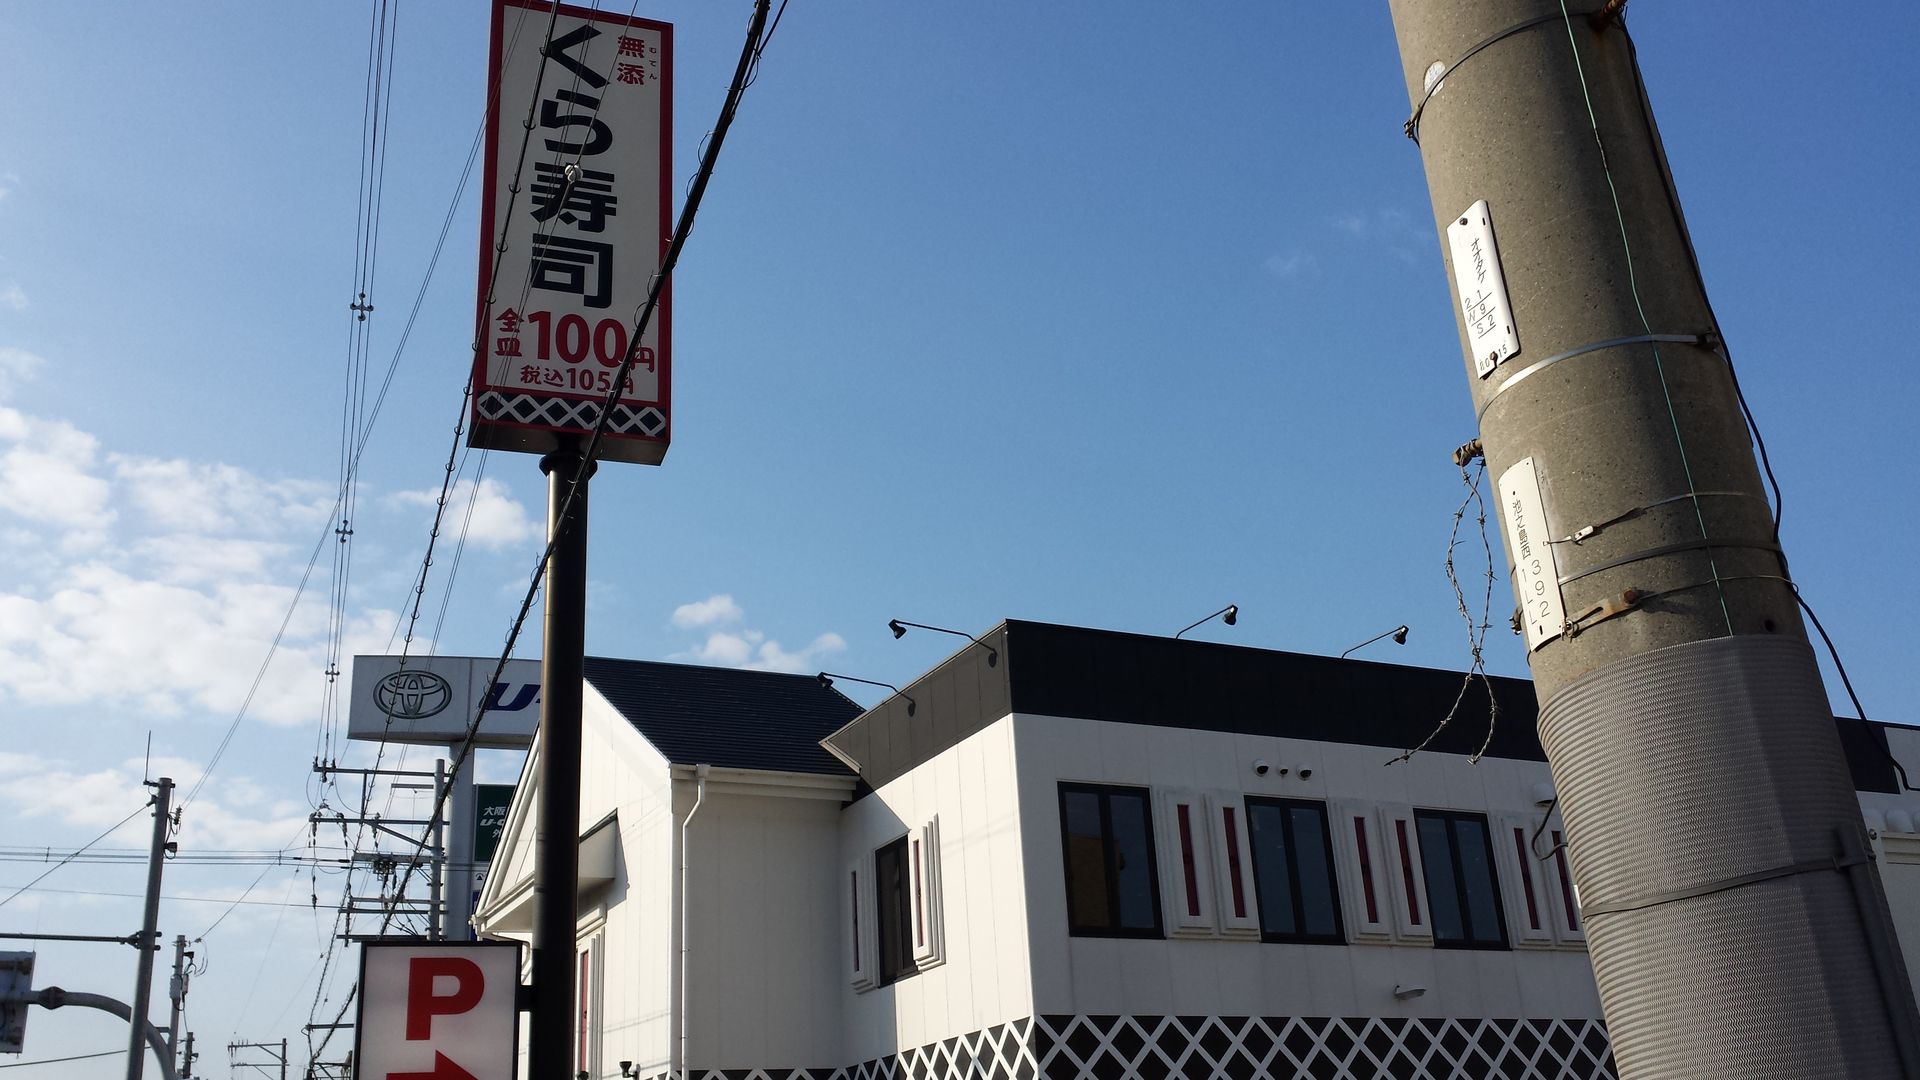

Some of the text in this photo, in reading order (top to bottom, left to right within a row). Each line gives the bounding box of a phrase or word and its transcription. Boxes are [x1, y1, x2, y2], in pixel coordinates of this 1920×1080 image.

[616, 35, 645, 86] 無添
[530, 24, 618, 309] くら寿司
[406, 957, 485, 1041] P
